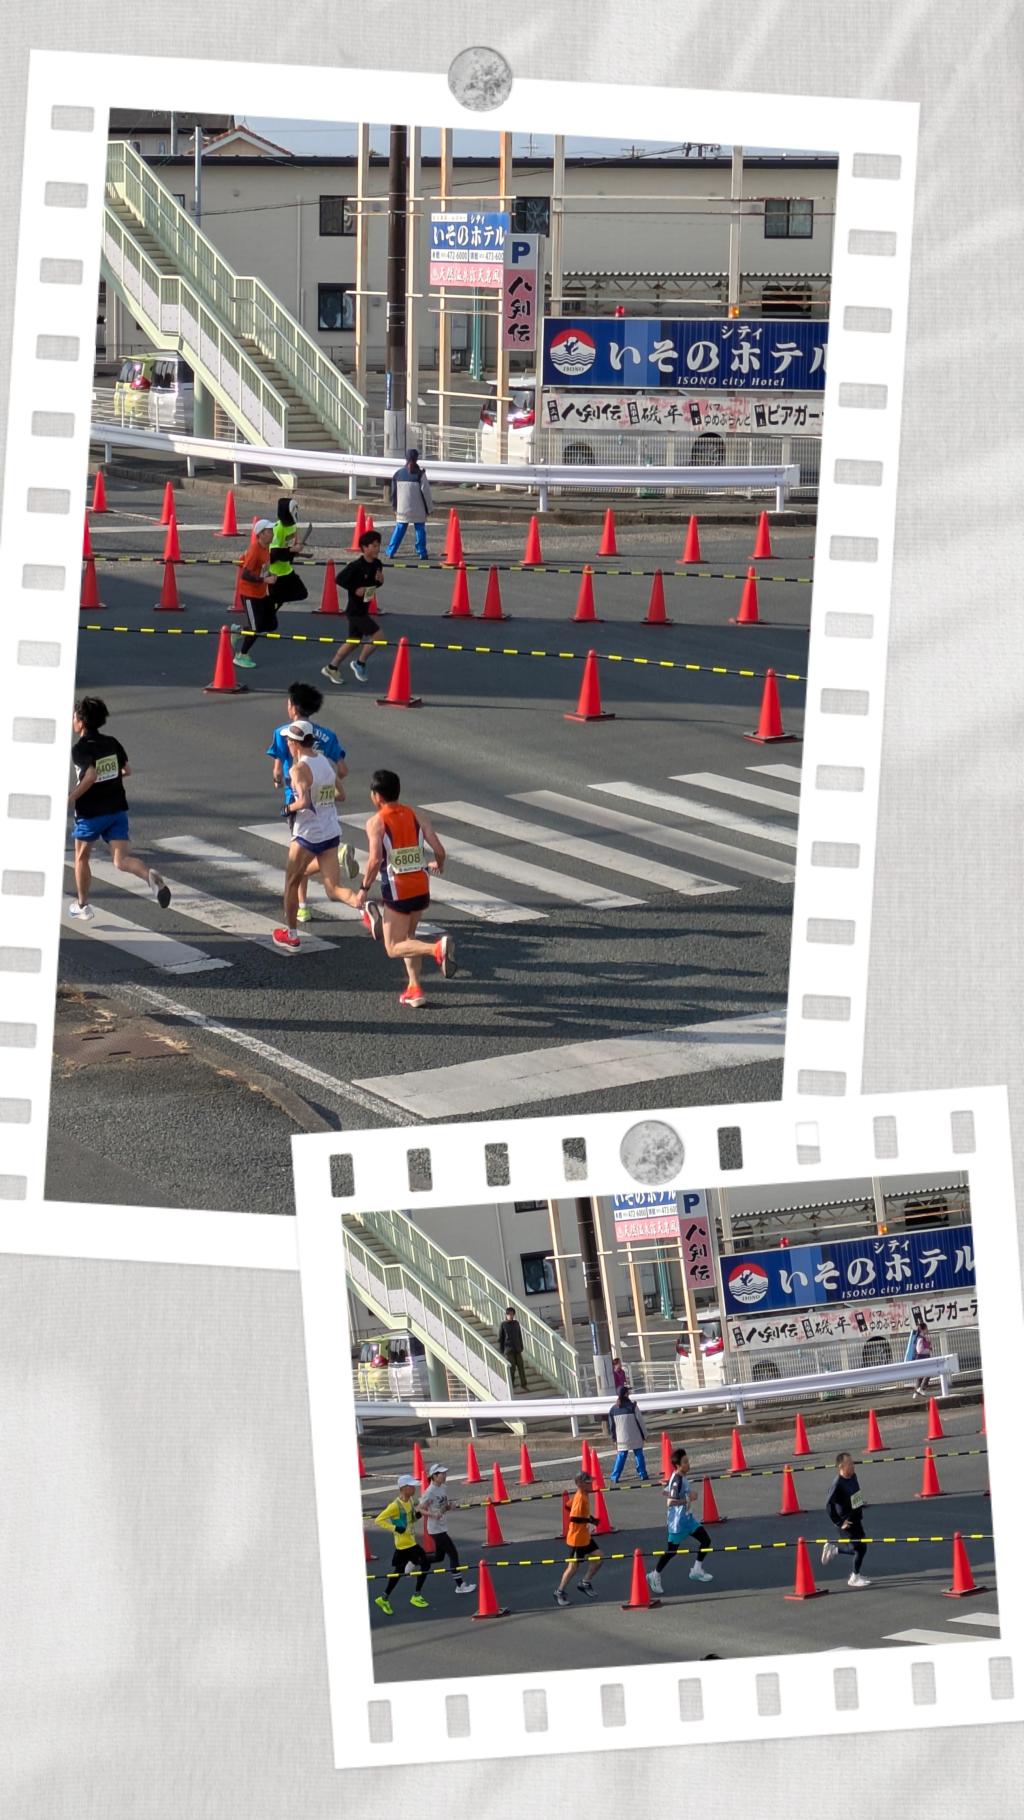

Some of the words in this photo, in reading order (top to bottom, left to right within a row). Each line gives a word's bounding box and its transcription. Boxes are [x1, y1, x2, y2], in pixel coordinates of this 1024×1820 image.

[433, 225, 505, 246] いそのホテル
[511, 241, 531, 264] P
[721, 325, 763, 340] シティ
[677, 376, 717, 385] ISONO
[722, 376, 746, 387] city
[751, 377, 785, 387] Hotel
[768, 405, 824, 426] ビアガー
[394, 853, 421, 866] 6808
[683, 1193, 700, 1214] P
[873, 1240, 910, 1254] シティ
[778, 1245, 975, 1294] いそのホテル
[842, 1287, 876, 1299] ISONO
[881, 1284, 901, 1295] city
[906, 1280, 935, 1291] Hotel
